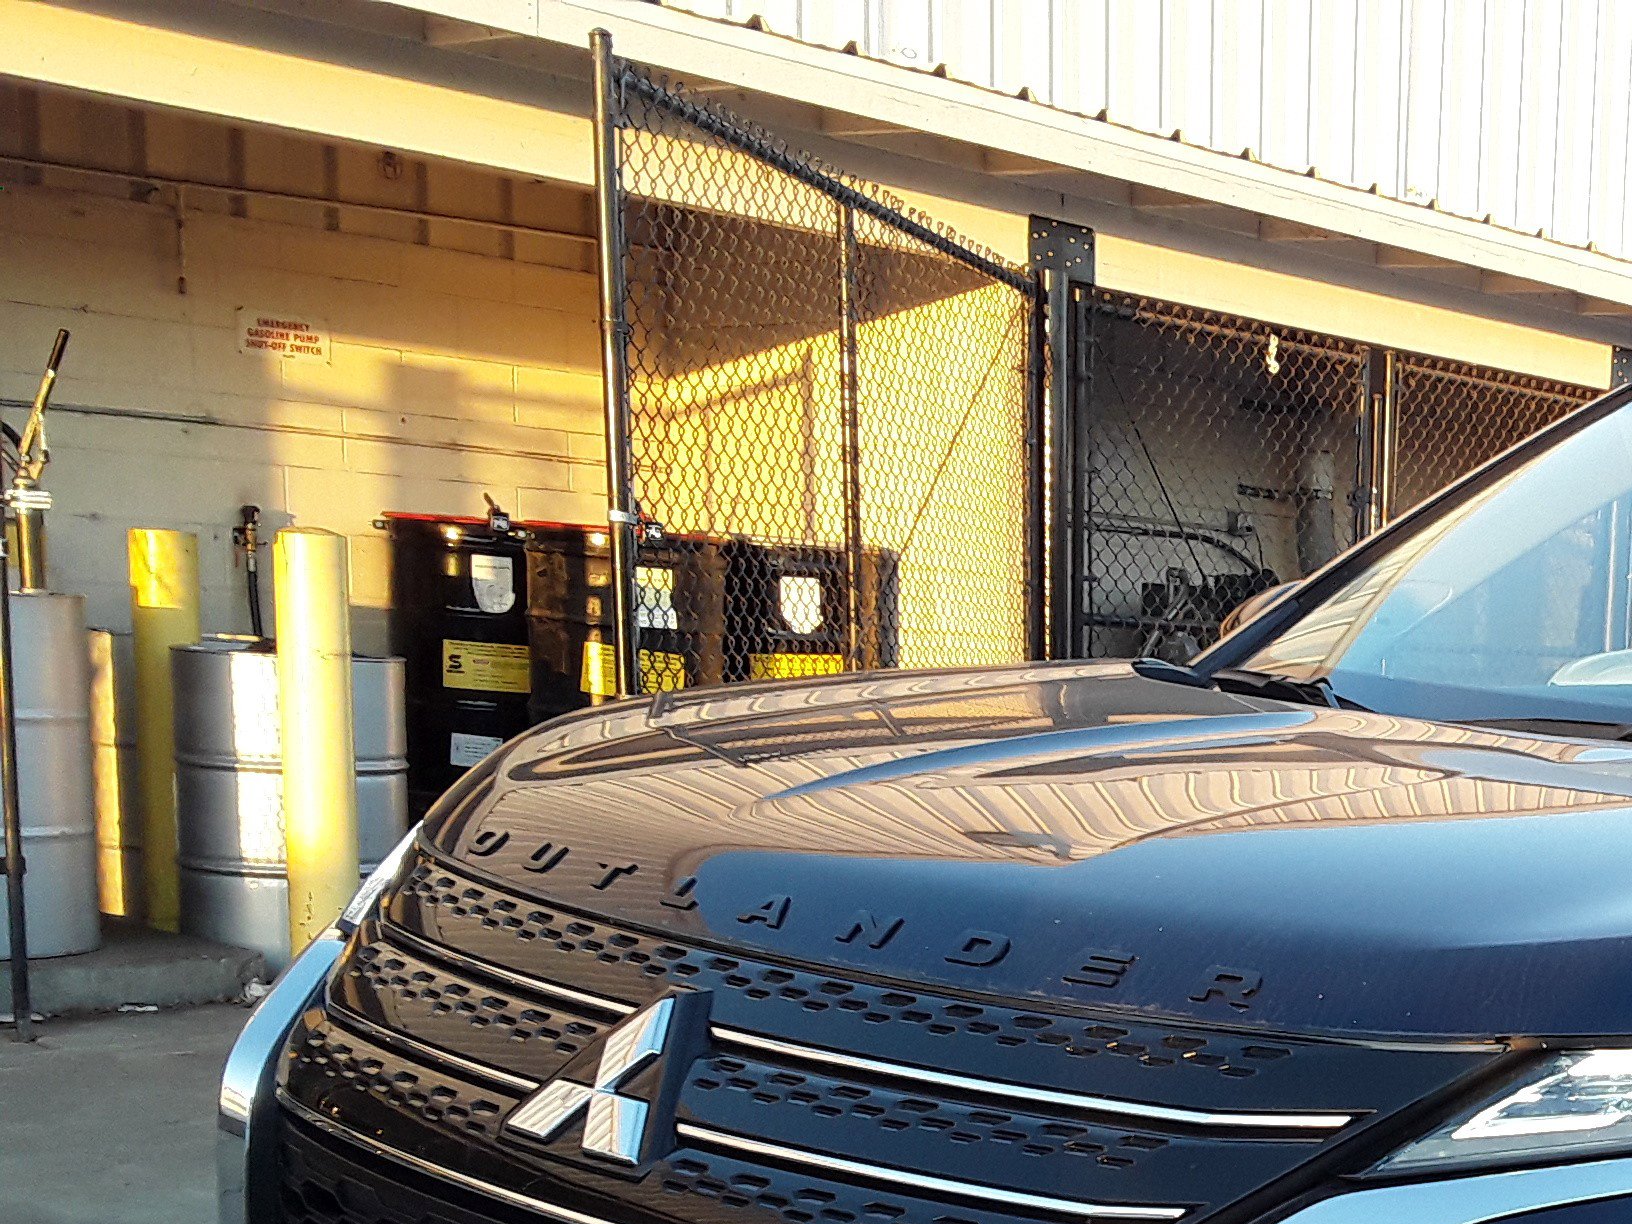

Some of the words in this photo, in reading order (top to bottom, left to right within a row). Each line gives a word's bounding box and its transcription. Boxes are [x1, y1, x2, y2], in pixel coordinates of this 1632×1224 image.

[256, 318, 310, 332] EMERGENCY
[247, 327, 291, 341] GASOLINE
[293, 333, 320, 344] PUMP
[244, 338, 287, 353] SHUT-OFF
[289, 343, 323, 356] SWITCH
[469, 829, 1264, 1012] OUTLANDER
